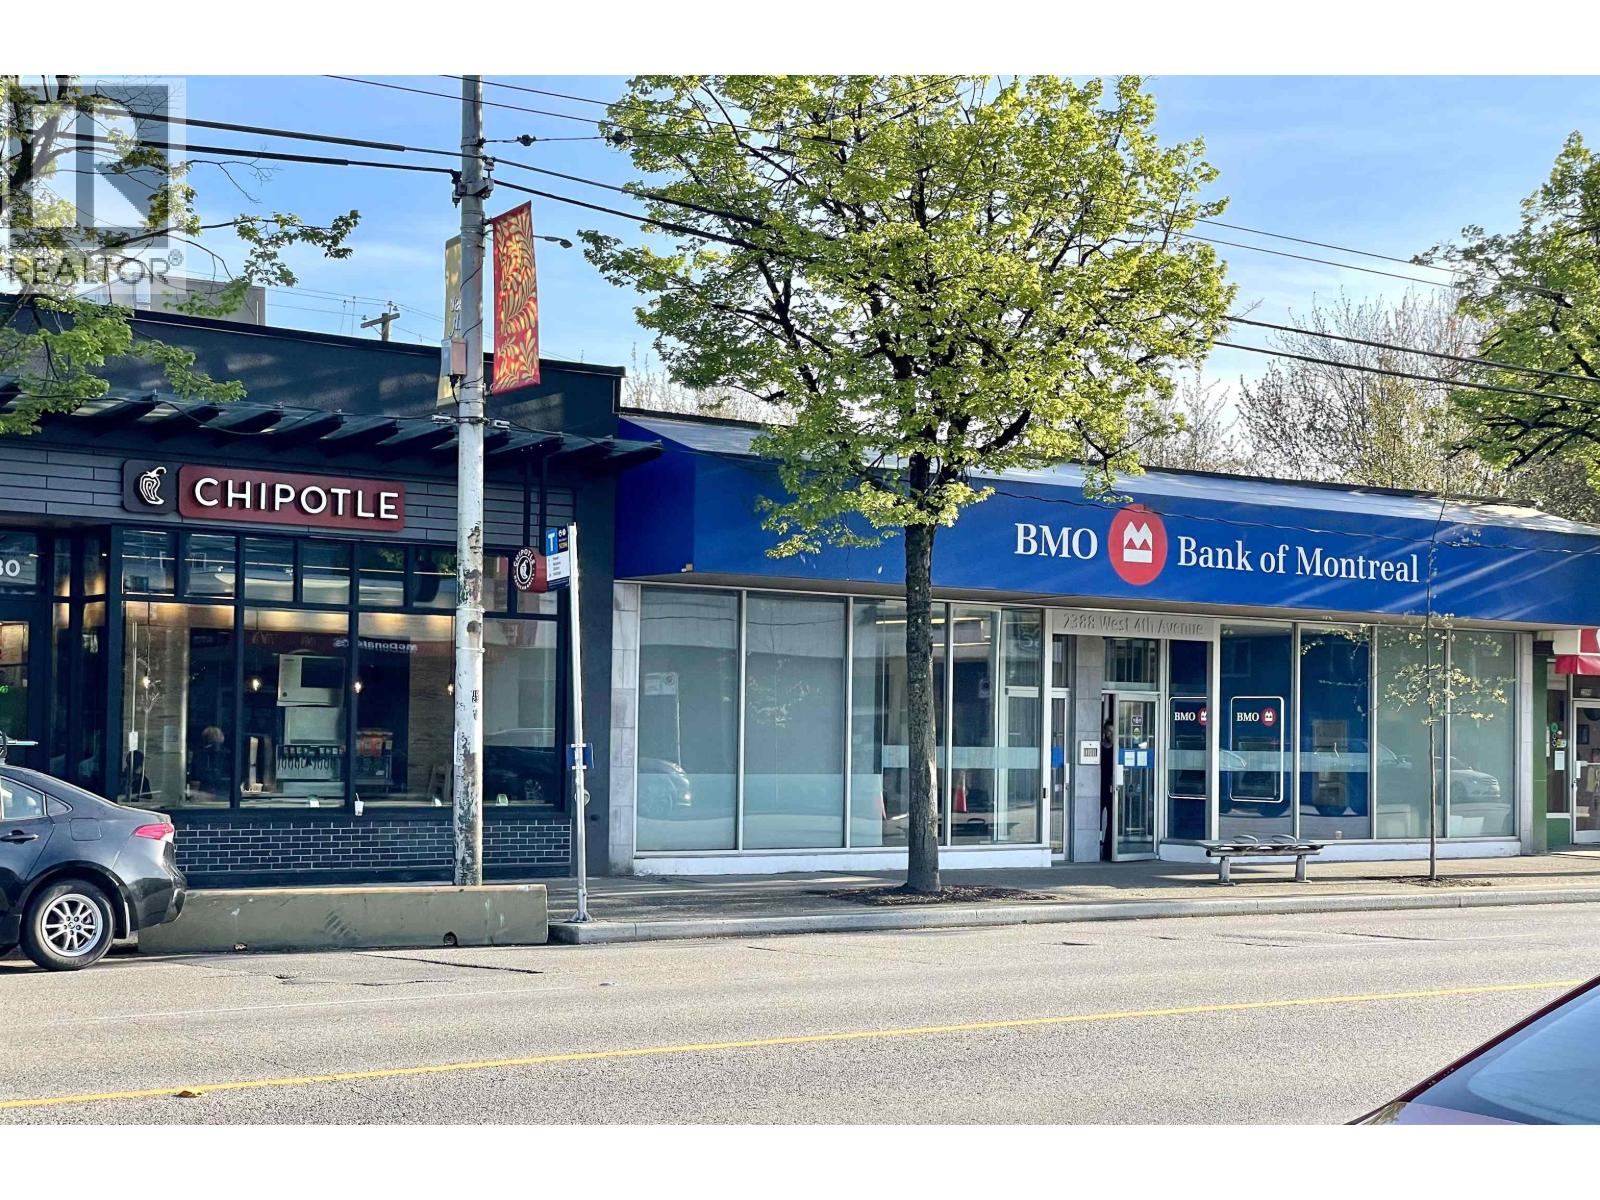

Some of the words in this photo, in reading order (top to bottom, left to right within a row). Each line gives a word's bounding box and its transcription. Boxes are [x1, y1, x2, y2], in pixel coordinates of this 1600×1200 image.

[195, 477, 399, 519] CHIPOTLE
[513, 548, 536, 567] CHIPOTLE
[1014, 522, 1098, 560] BMO
[1177, 535, 1254, 571] Bank
[1260, 544, 1289, 574] of
[1296, 546, 1420, 583] Montreal
[0, 559, 21, 577] 0
[1063, 613, 1096, 629] 2388
[1100, 615, 1129, 632] West
[1157, 619, 1204, 636] Avenue
[1174, 711, 1196, 721] BMO
[1236, 712, 1260, 722] BMO
